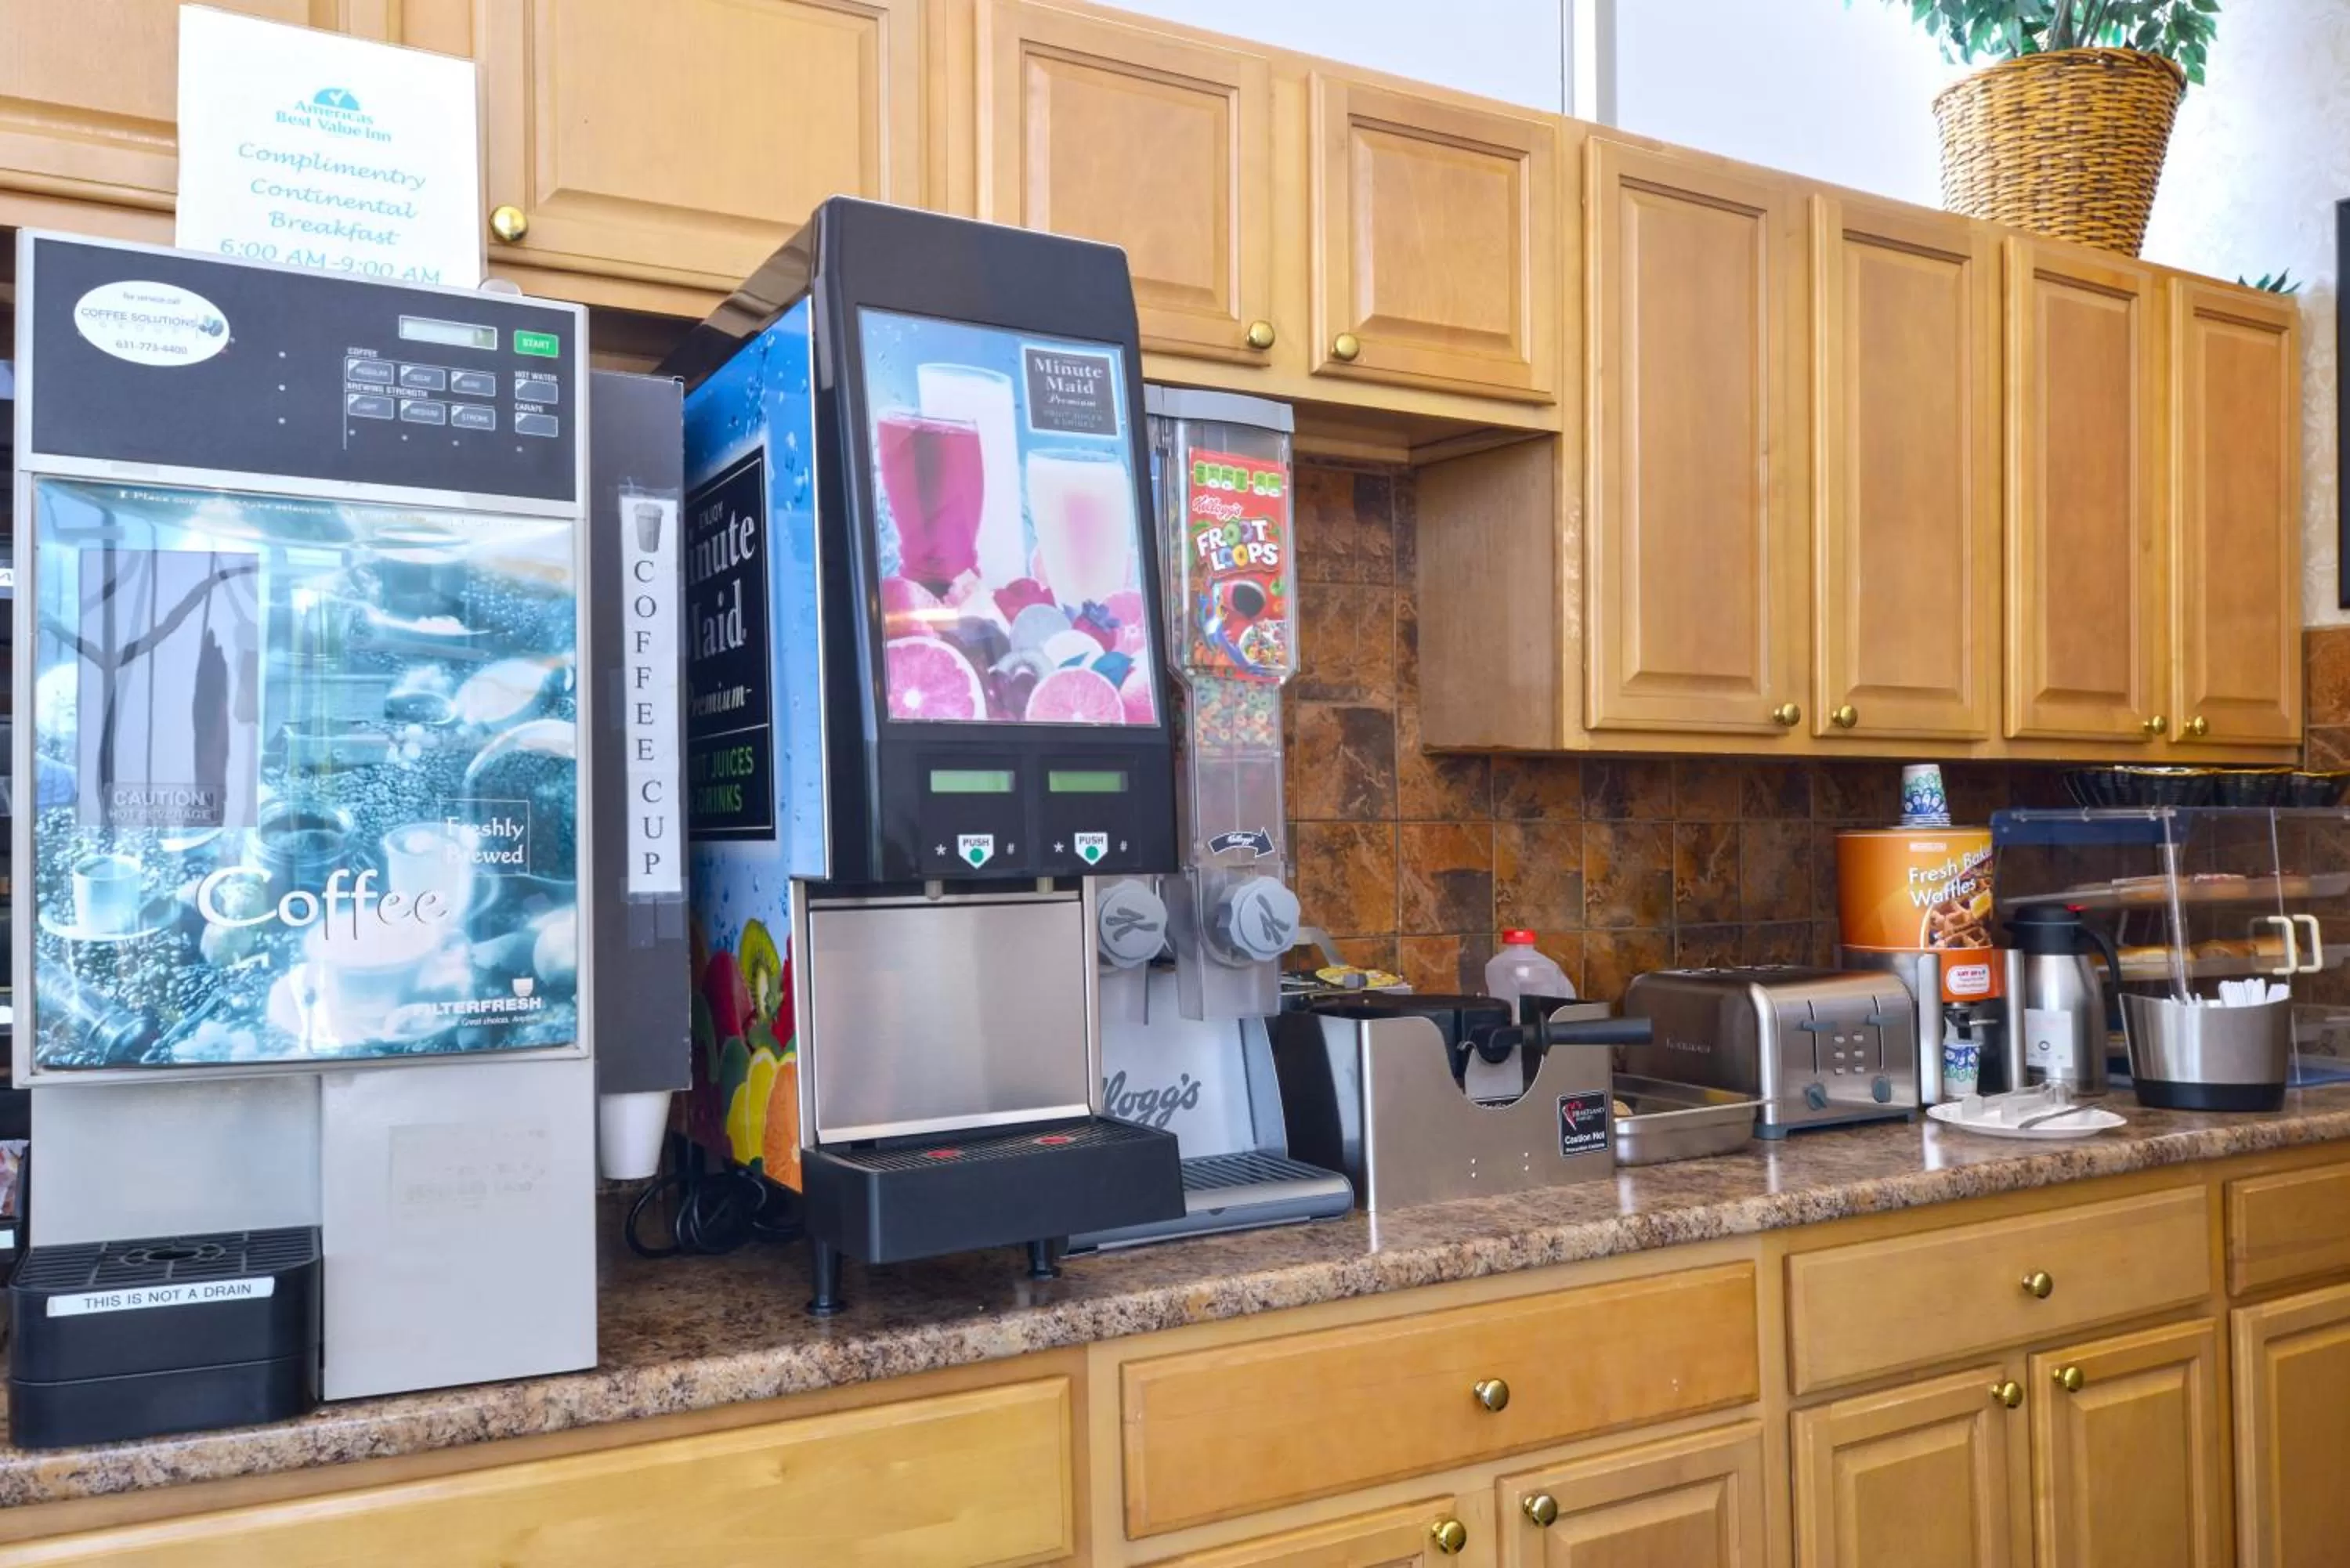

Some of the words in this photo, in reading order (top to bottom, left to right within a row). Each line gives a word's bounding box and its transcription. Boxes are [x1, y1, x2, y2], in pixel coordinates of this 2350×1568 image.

[274, 110, 312, 128] Best
[317, 115, 362, 137] Value
[365, 127, 392, 143] Inn
[294, 99, 374, 125] Americas
[237, 141, 427, 190] Complimentry
[249, 177, 418, 219] Continental
[268, 211, 401, 246] Breakfast
[220, 238, 277, 261] 6:00
[402, 267, 441, 286] AM
[81, 306, 128, 320] COFFEE
[522, 338, 551, 349] START
[1035, 356, 1104, 378] Minute
[1046, 376, 1095, 394] Maid
[688, 510, 757, 586] inute
[1196, 519, 1267, 556] FROOT
[1210, 543, 1278, 570] LOOPS
[634, 559, 657, 762] COFFEE
[114, 789, 205, 806] CAUTION
[641, 779, 665, 876] CUP
[963, 838, 989, 847] PUSH
[1079, 836, 1104, 844] PUSH
[1908, 858, 1958, 885] Fresh
[1963, 843, 1992, 870] Bake
[197, 865, 450, 941] Coffee
[1910, 876, 1976, 908] Waffles
[414, 996, 542, 1017] LTERFRESH
[1103, 1070, 1202, 1129] logg's
[84, 1297, 121, 1310] THIS
[127, 1294, 143, 1305] IS
[147, 1289, 182, 1303] NOT
[187, 1288, 198, 1299] A
[204, 1284, 252, 1299] DRAIN
